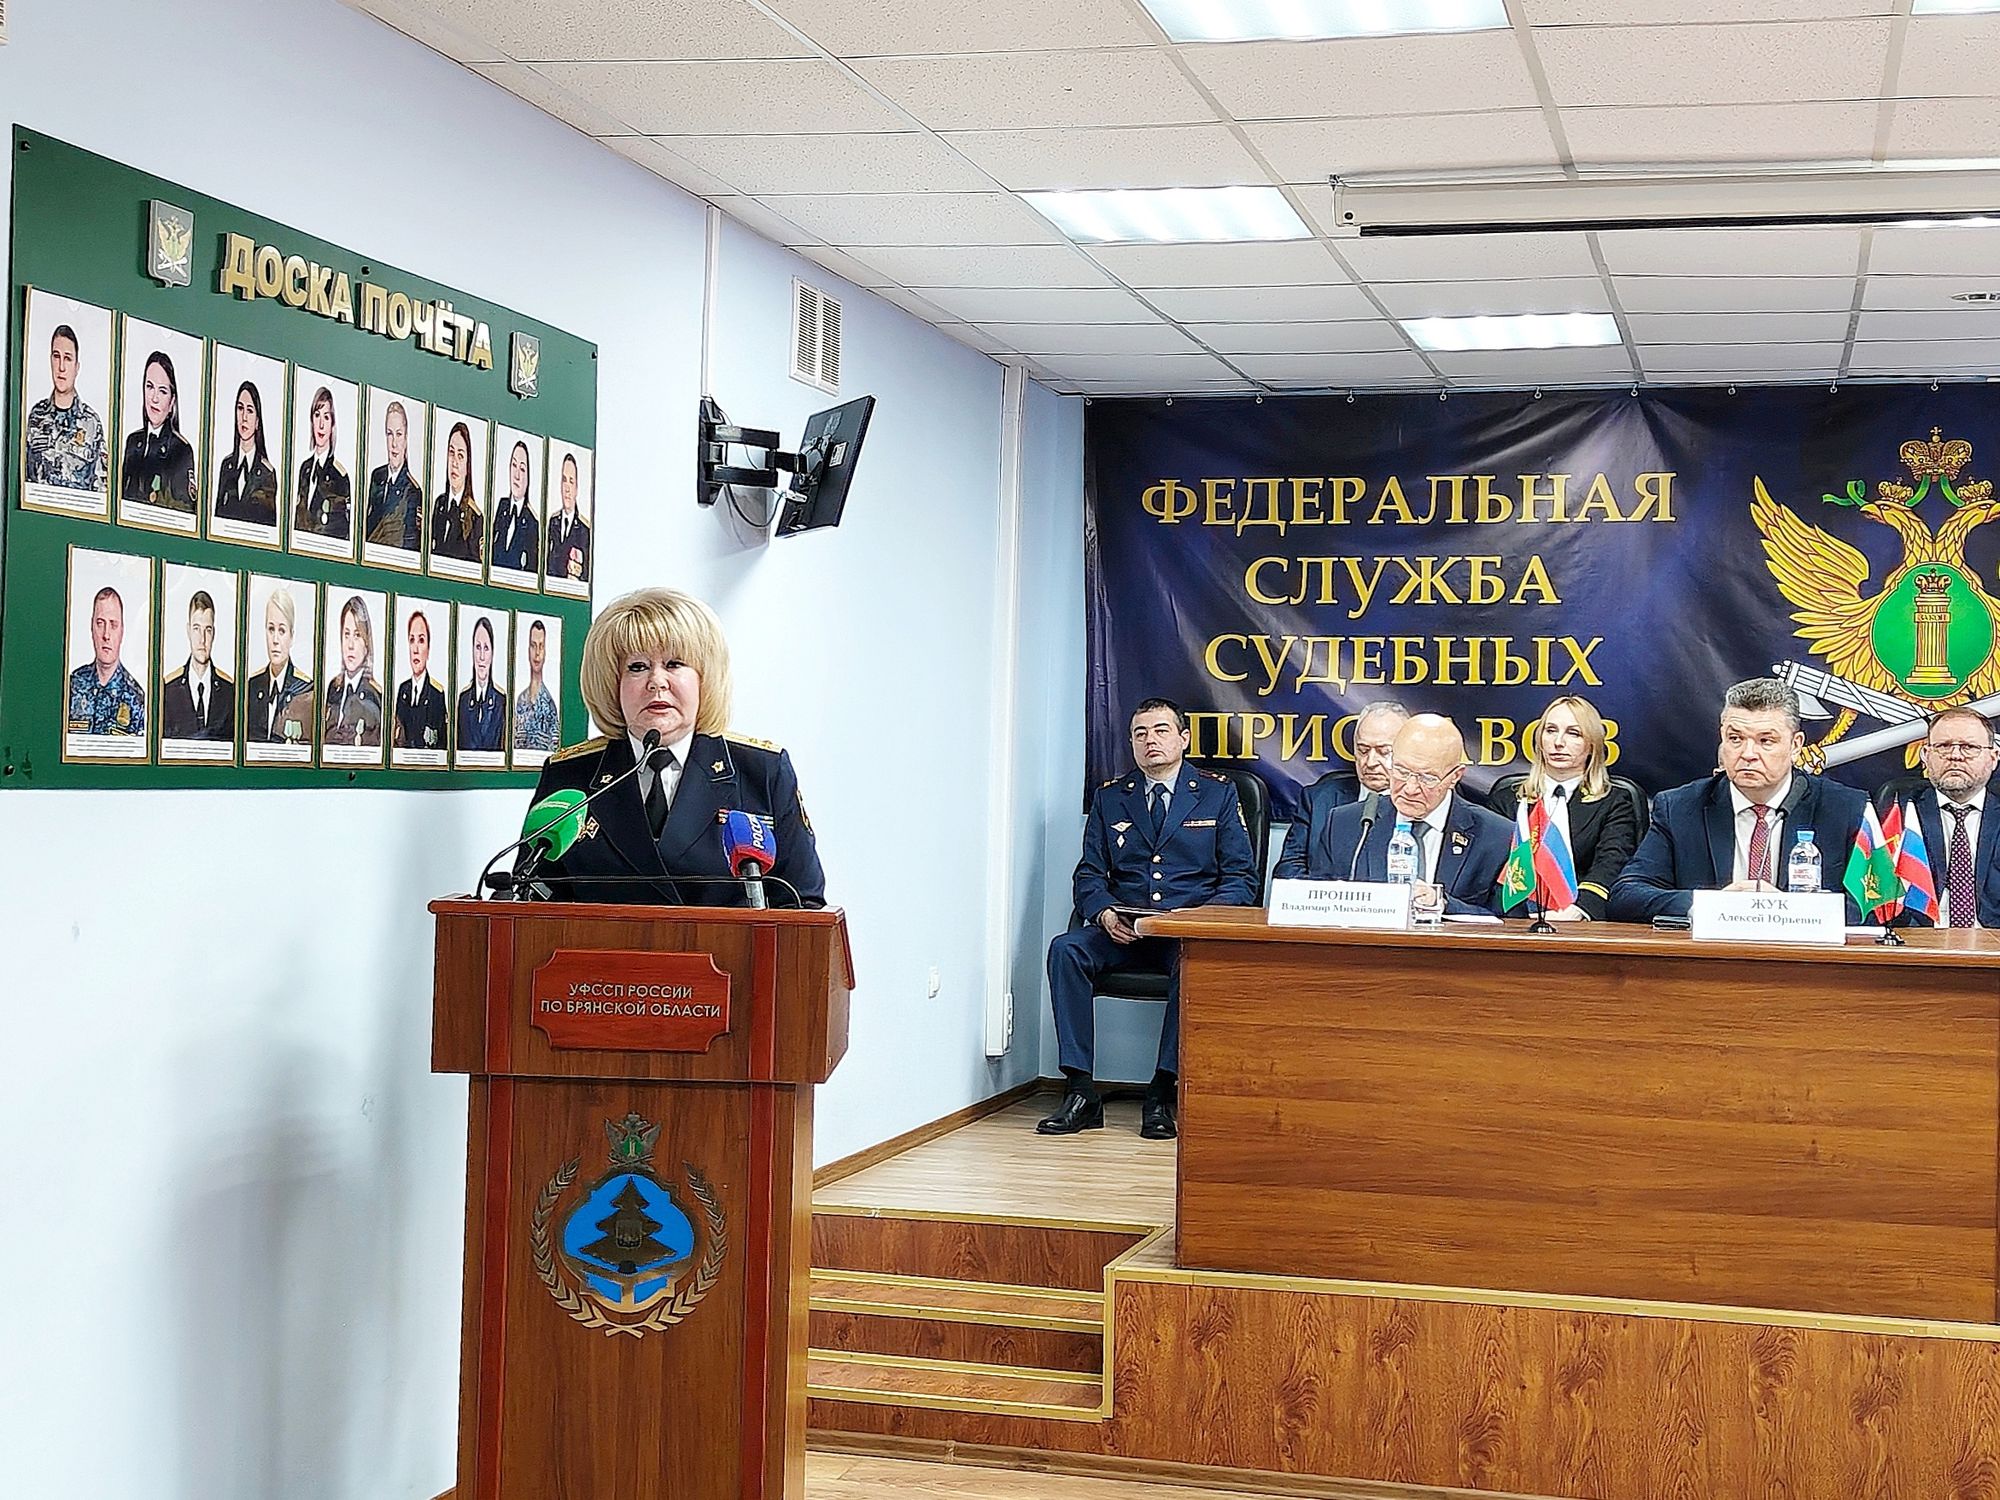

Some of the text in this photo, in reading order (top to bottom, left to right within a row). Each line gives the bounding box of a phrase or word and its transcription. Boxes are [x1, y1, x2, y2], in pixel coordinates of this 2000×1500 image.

[219, 232, 494, 370] ДОСКА ПОЧЁТА
[1141, 472, 1677, 536] ФЕДЕРАЛЬНАЯ
[1244, 554, 1562, 619] СЛУЖБА
[1204, 634, 1604, 695] СУДЕБНЫХ
[1308, 890, 1372, 901] ПРОНИН
[1281, 902, 1396, 915] Владимир Михайлович
[1750, 898, 1789, 911] ЖУК
[1717, 912, 1822, 926] Алексей Юрьевич
[569, 983, 693, 999] УФССП РОССИИ
[540, 1000, 721, 1018] ПО БРЯНСКОЙ ОБЛАСТИ
